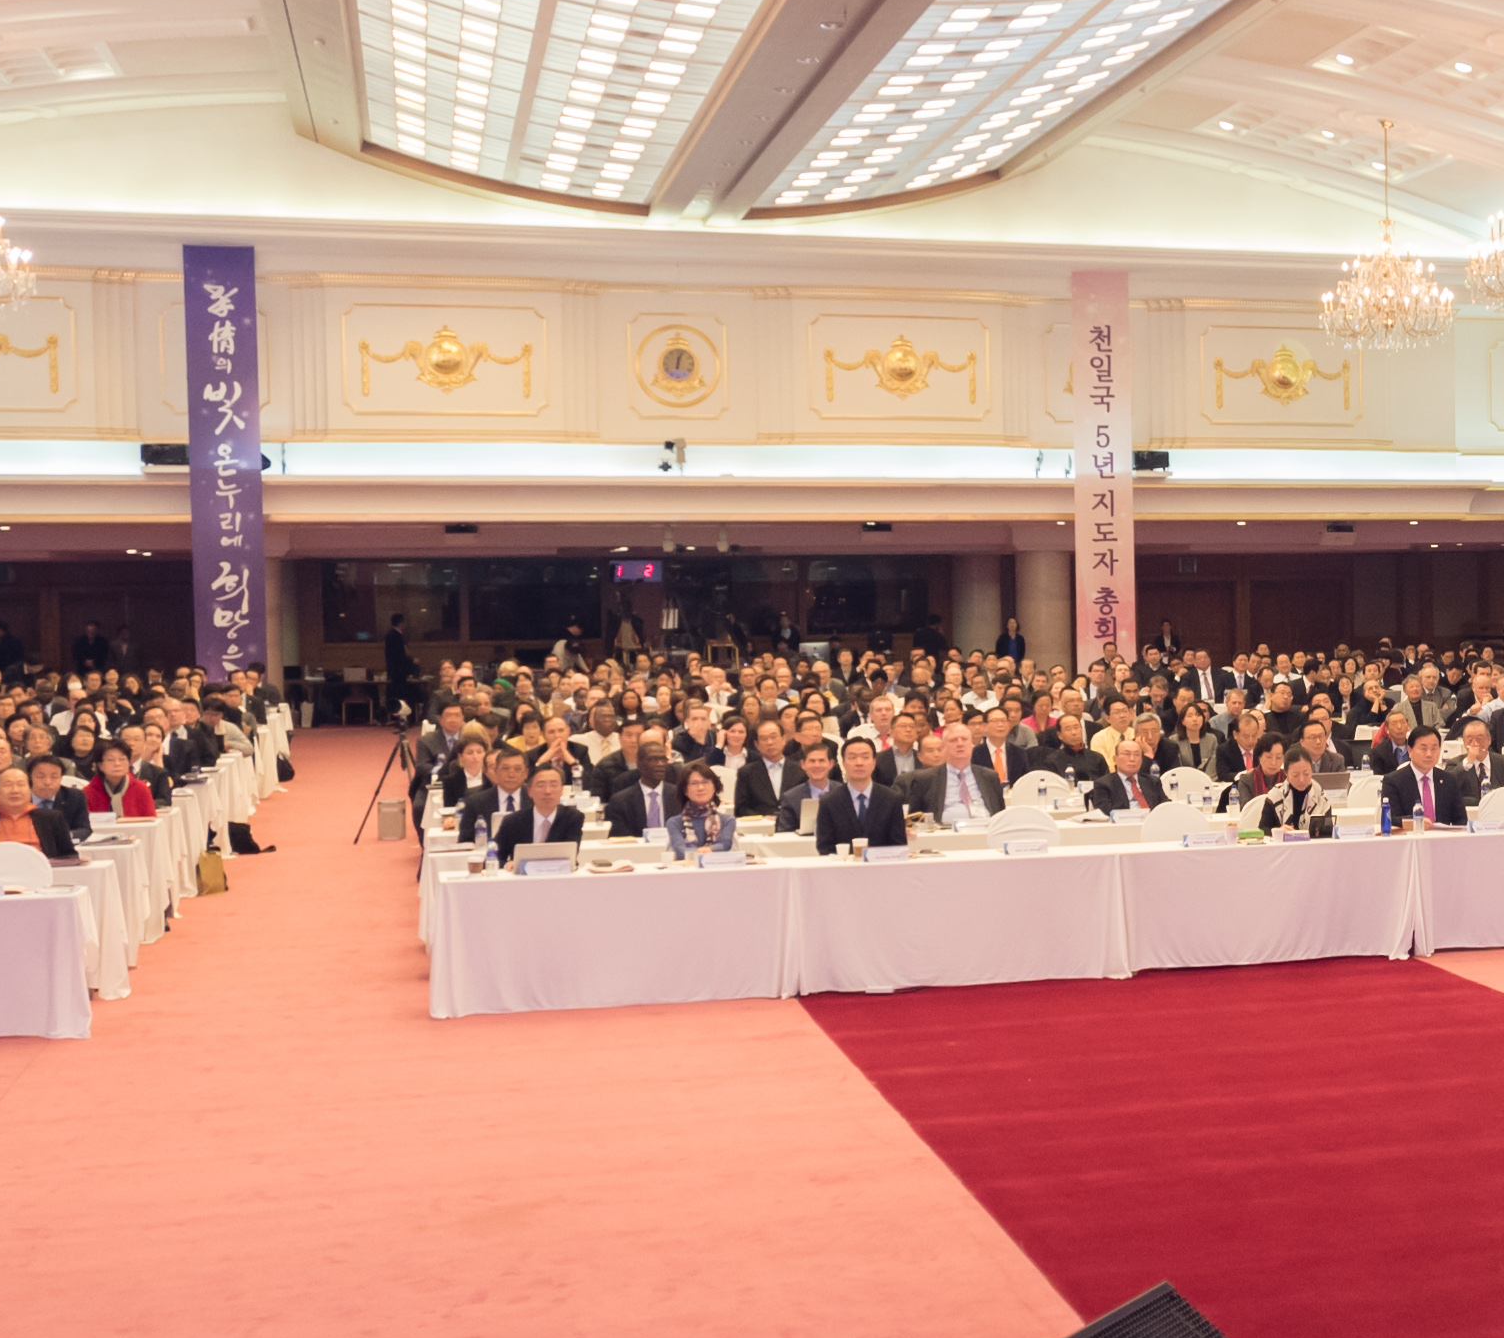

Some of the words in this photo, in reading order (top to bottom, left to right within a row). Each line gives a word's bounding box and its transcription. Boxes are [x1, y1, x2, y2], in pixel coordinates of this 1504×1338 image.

[1089, 324, 1115, 413] 천일국
[203, 380, 246, 436] 빛
[1092, 424, 1115, 479] 5년
[1092, 489, 1118, 576] 지도자
[1092, 586, 1120, 643] 총회
